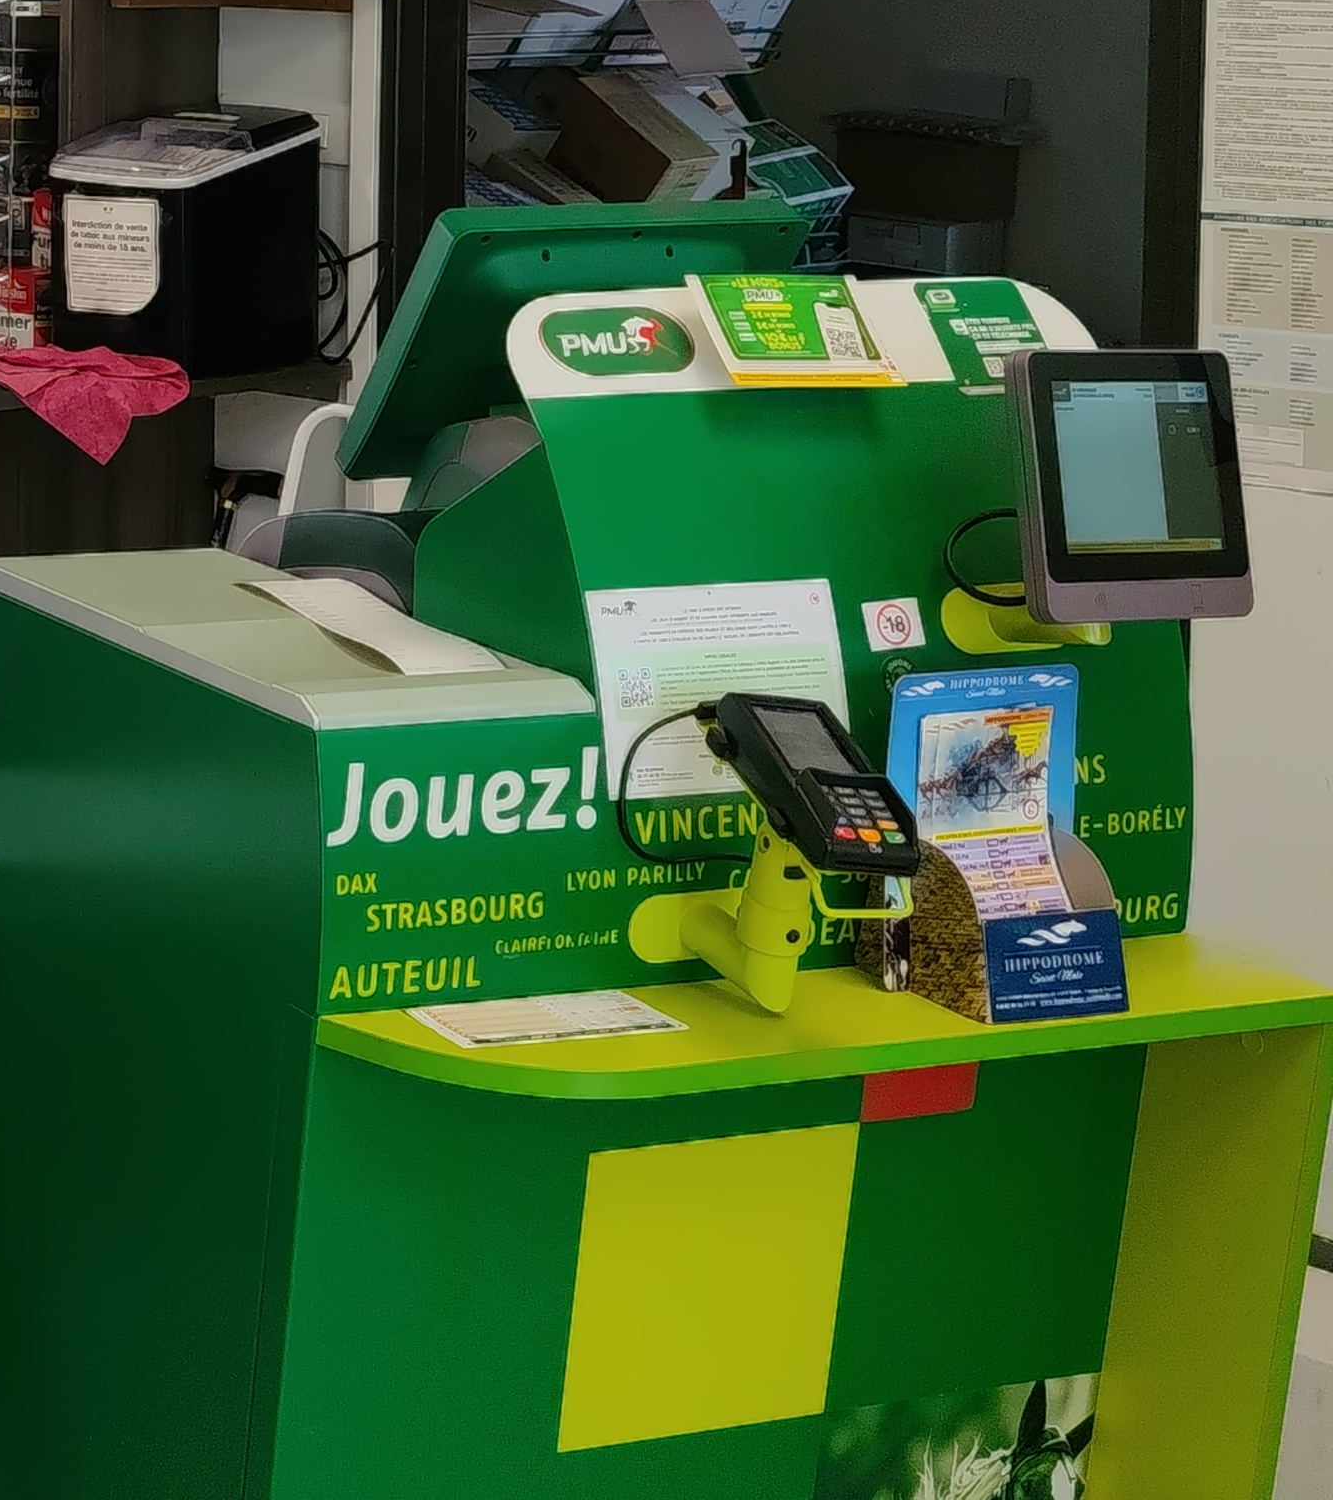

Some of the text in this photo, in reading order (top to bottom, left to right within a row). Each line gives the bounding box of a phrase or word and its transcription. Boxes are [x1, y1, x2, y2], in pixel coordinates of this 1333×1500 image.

[72, 220, 148, 232] Interdiction de vente
[80, 231, 100, 239] tabac
[118, 234, 150, 242] mineurs
[73, 241, 83, 249] de
[84, 242, 105, 250] moins
[107, 243, 117, 251] de
[120, 243, 128, 252] 18
[745, 289, 774, 301] PMU
[556, 329, 630, 357] PMU
[600, 606, 624, 617] PMU
[950, 673, 1024, 690] HIPPODROME
[327, 746, 600, 847] Jouez!
[635, 803, 758, 845] VINCEN
[336, 872, 378, 896] DAX
[566, 861, 706, 893] LYON PARILLY
[366, 891, 544, 932] STRASBOURG
[1004, 951, 1104, 973] HIPPODROME
[329, 955, 481, 999] AUTEUIL
